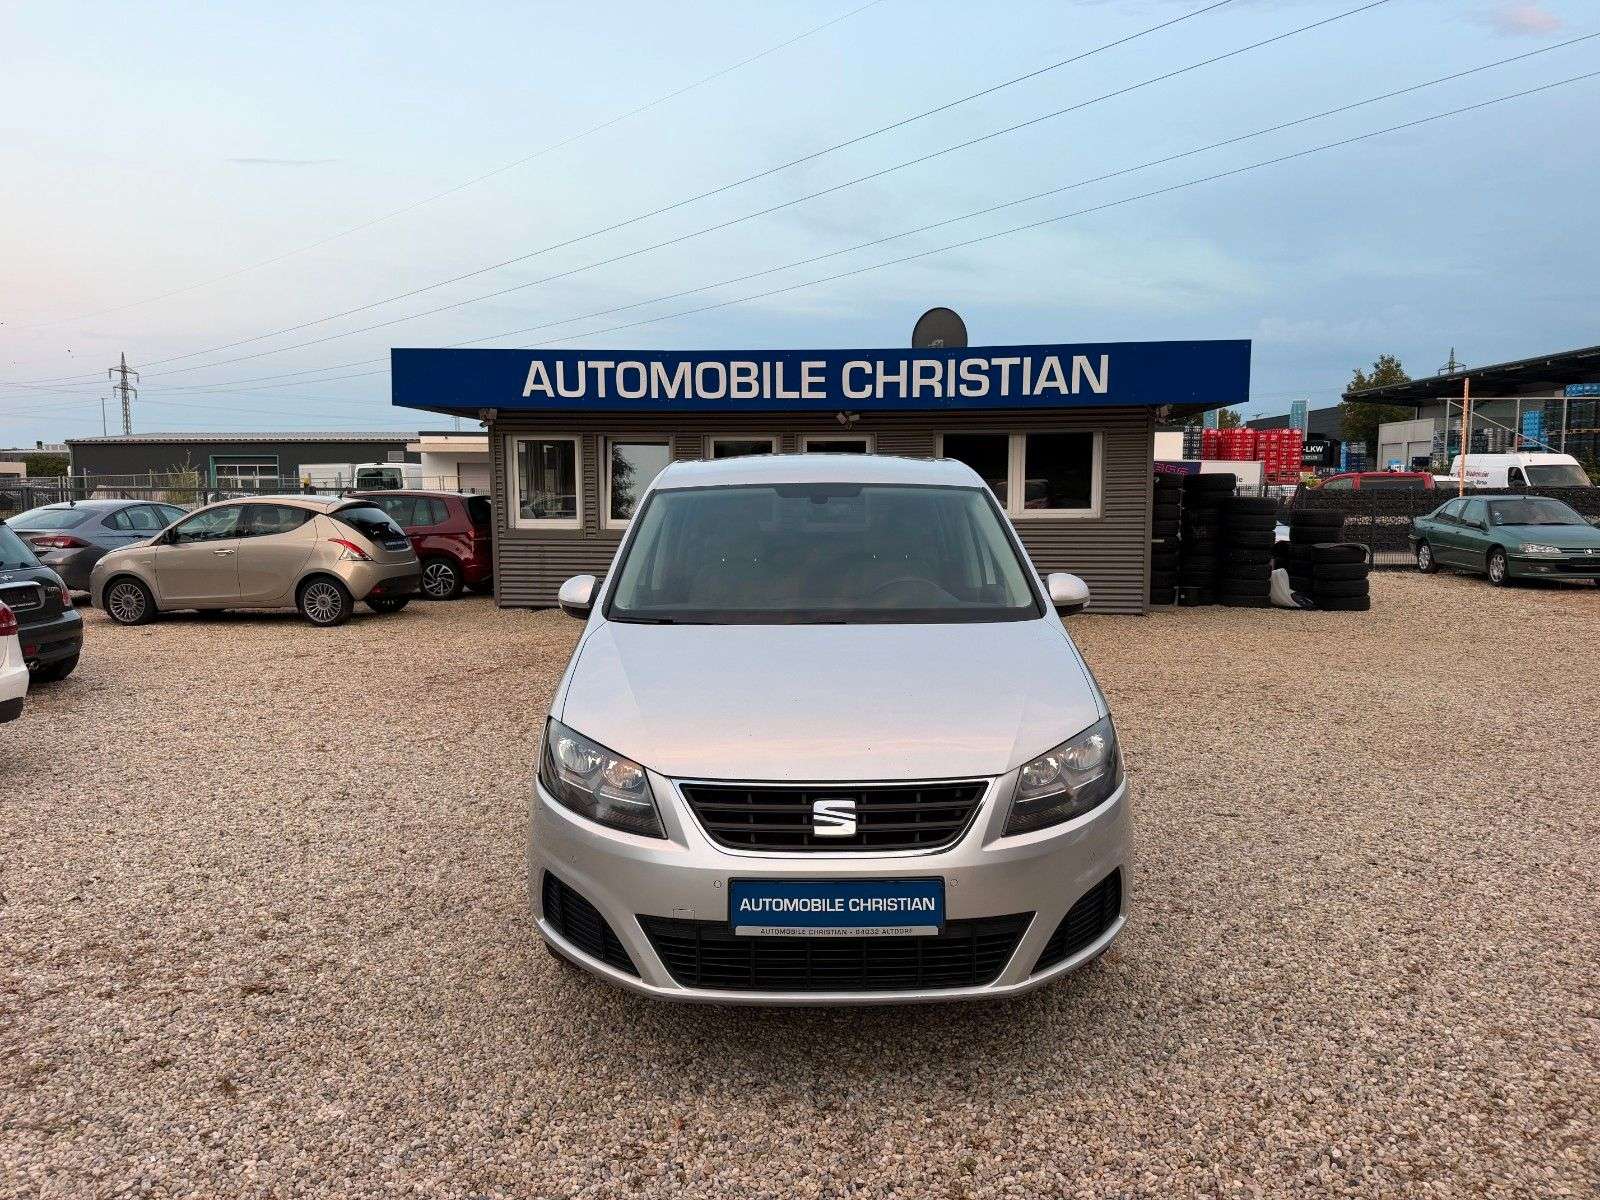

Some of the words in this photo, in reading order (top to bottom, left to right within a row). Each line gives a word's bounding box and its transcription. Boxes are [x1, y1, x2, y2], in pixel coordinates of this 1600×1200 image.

[522, 360, 827, 400] AUTOMOBILE
[841, 354, 1109, 399] CHRISTIAN
[739, 898, 845, 912] AUTOMOBILE
[848, 897, 936, 912] CHRISTIAN
